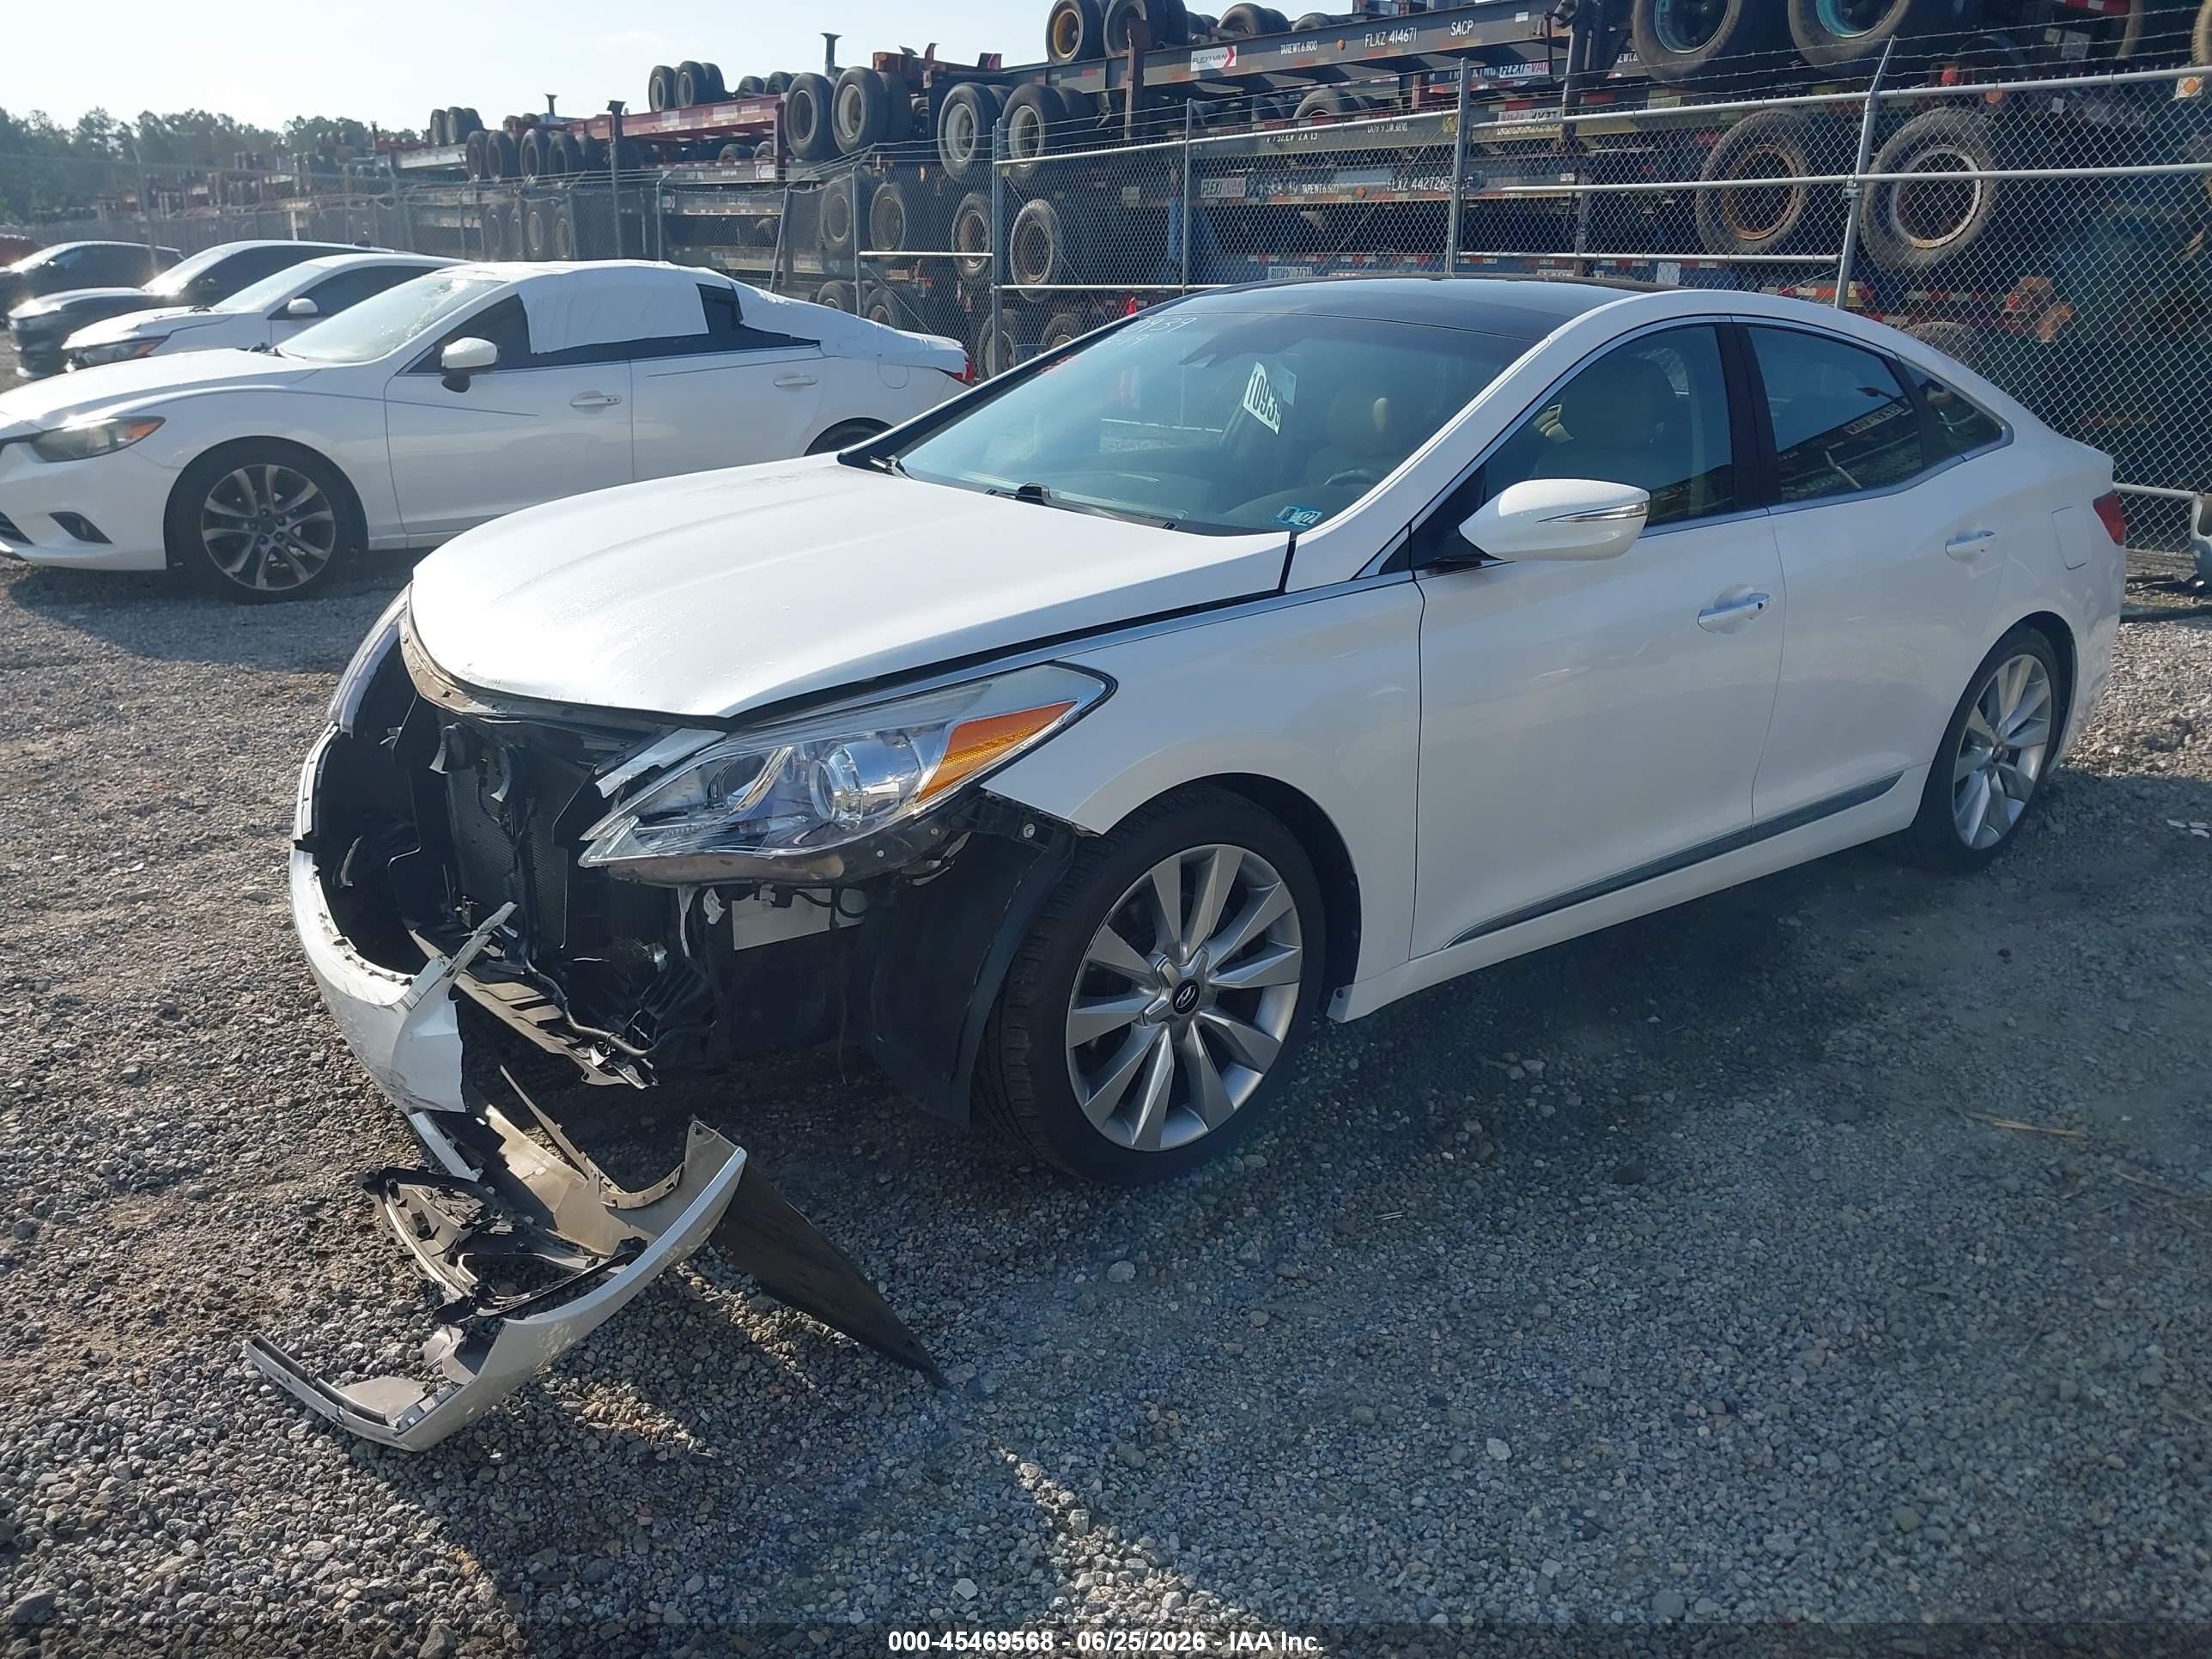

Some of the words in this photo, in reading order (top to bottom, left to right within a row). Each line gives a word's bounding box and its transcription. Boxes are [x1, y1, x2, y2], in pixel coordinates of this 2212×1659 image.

[1364, 31, 1386, 48] FLXZ
[1389, 27, 1417, 45] 414671
[1450, 20, 1474, 36] SACP
